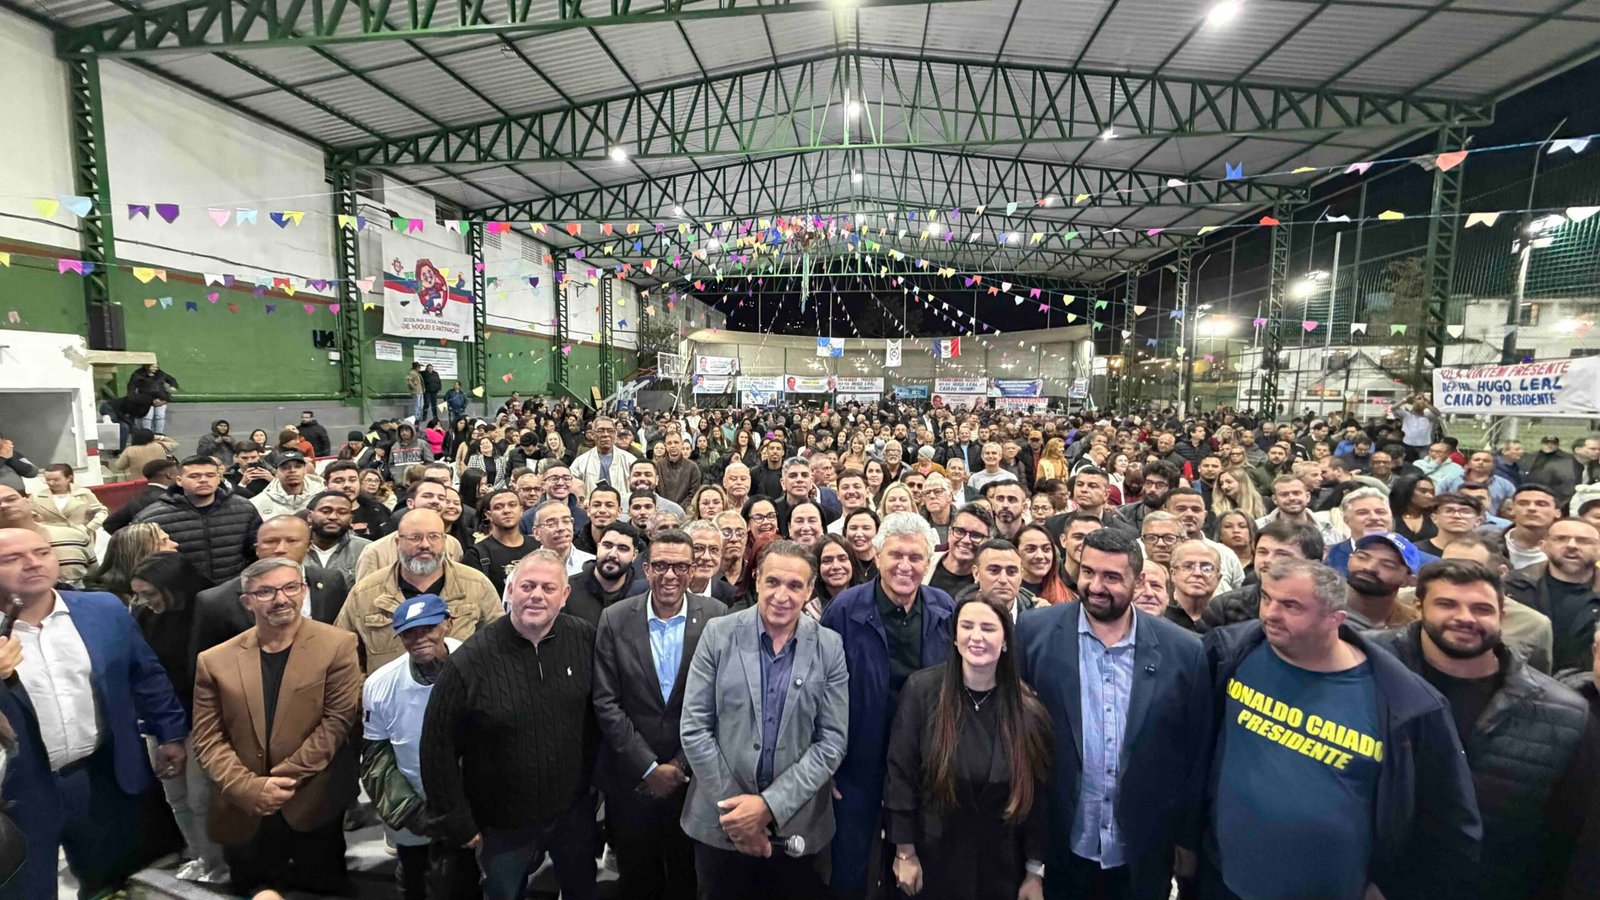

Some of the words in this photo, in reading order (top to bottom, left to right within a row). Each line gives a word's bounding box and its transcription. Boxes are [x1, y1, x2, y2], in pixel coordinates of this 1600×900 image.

[1466, 366, 1509, 379] VINTEM
[1508, 361, 1571, 377] PRESENTE
[1477, 380, 1512, 392] HUGO
[1519, 376, 1562, 391] LEAL
[1444, 394, 1492, 406] CAIADO
[1499, 393, 1557, 406] PRESIDENTE
[1237, 709, 1354, 770] PRESIDENTE
[1305, 714, 1383, 762] CAIADO
